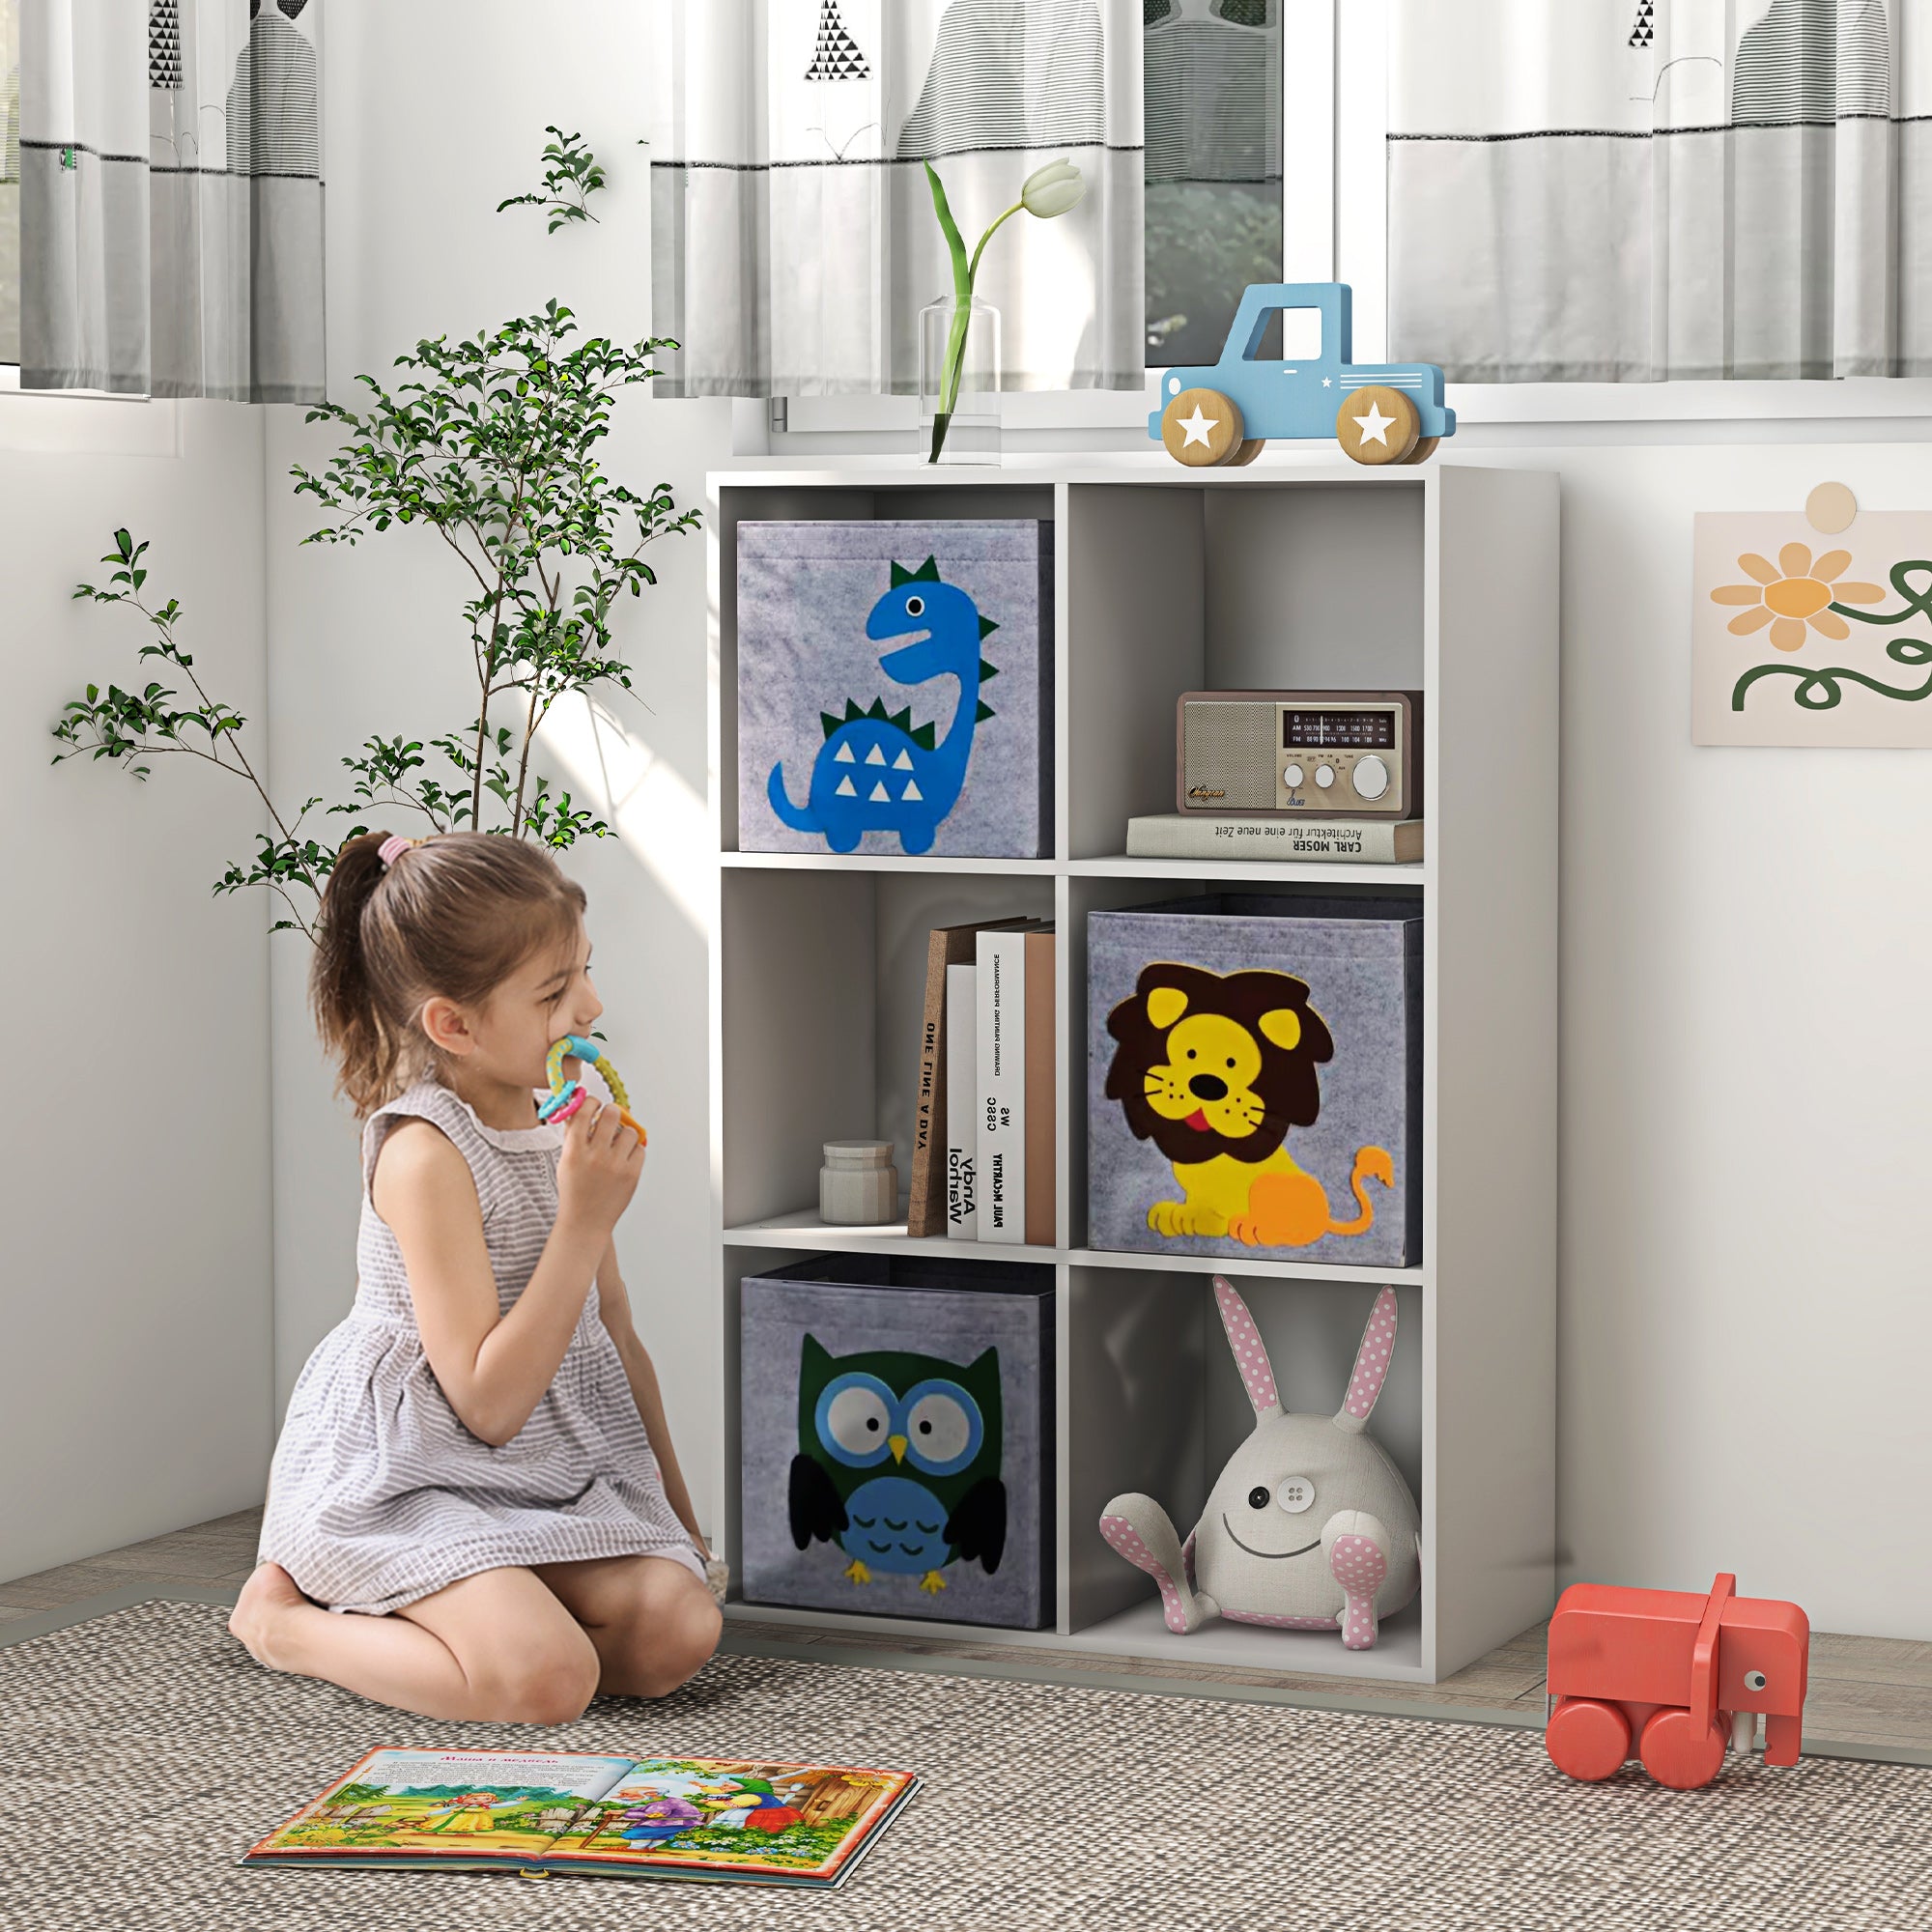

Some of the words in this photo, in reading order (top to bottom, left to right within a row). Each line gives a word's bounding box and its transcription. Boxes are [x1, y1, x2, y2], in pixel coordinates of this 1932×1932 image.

[1214, 826, 1235, 838] Zeit
[1236, 826, 1262, 836] neue
[1264, 827, 1286, 838] eine
[1288, 828, 1304, 839] für
[1306, 828, 1363, 841] Architektur
[1293, 839, 1330, 852] MOSER
[1334, 841, 1362, 853] CARL
